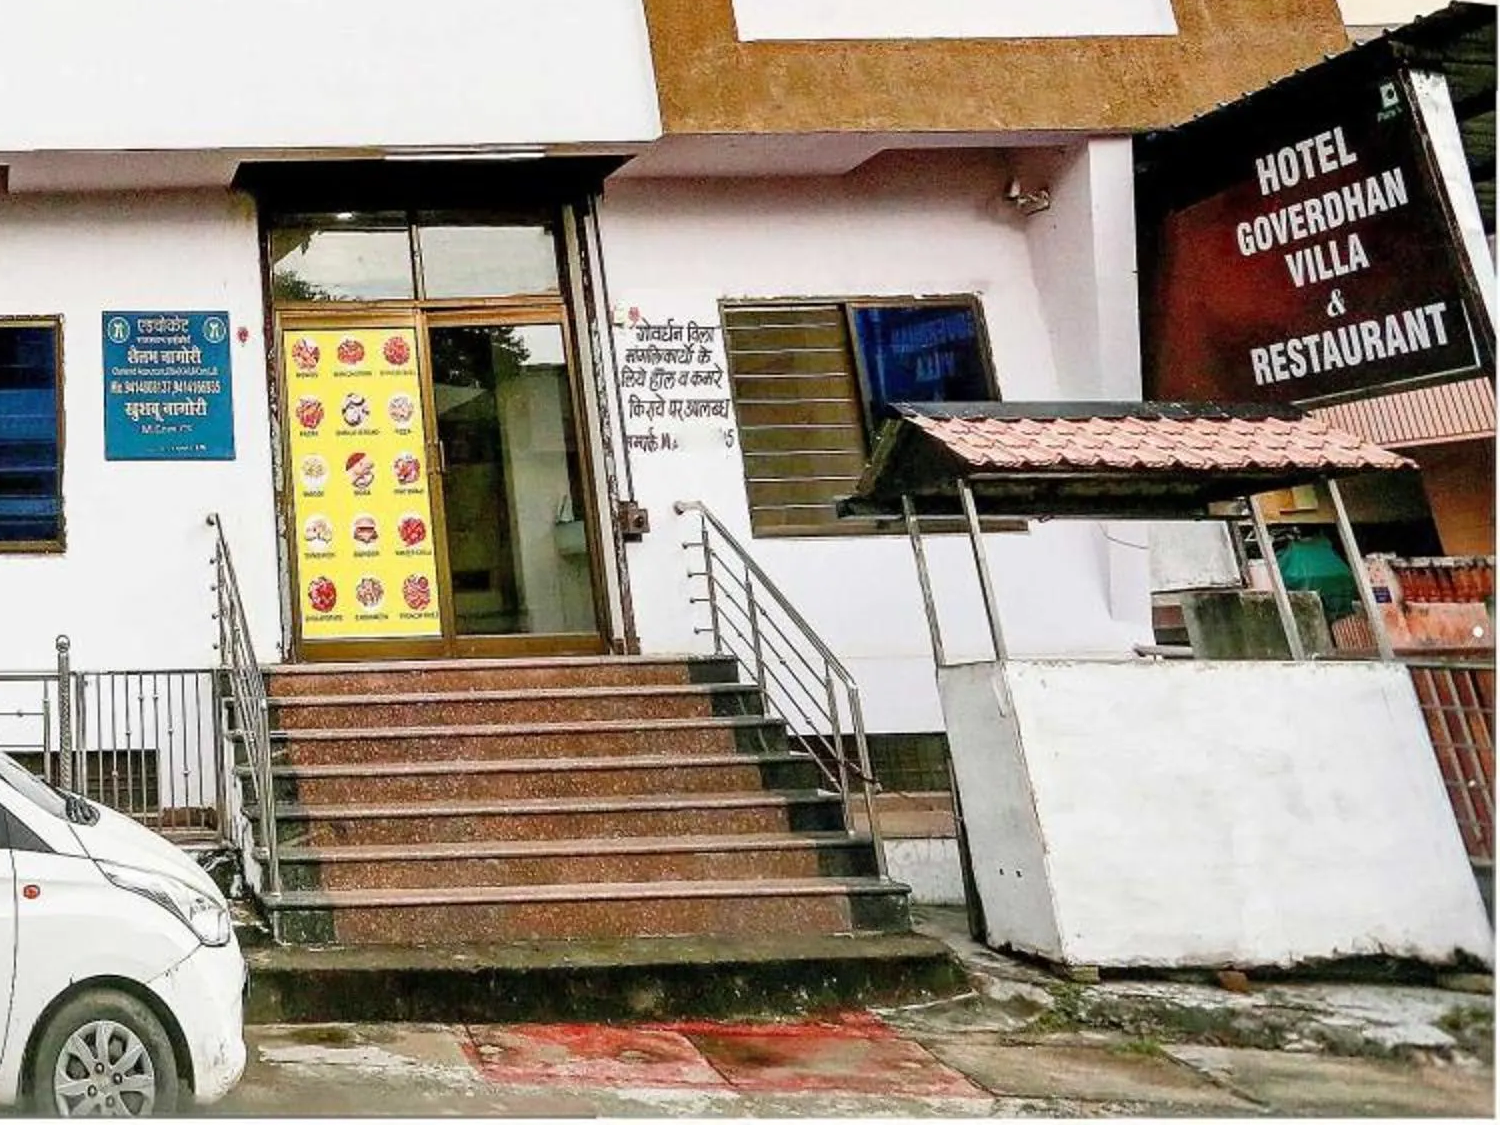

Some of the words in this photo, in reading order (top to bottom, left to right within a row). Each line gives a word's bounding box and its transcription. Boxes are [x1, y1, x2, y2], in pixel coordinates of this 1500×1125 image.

[1255, 126, 1357, 195] HOTEL
[1236, 167, 1409, 256] GOVERDHAN
[1285, 233, 1370, 287] VILLA
[1326, 289, 1347, 317] &
[635, 318, 683, 343] गोवर्धन
[687, 320, 716, 343] विला
[1251, 302, 1448, 385] RESTAURANT
[698, 345, 713, 365] के
[689, 363, 724, 389] कमरे
